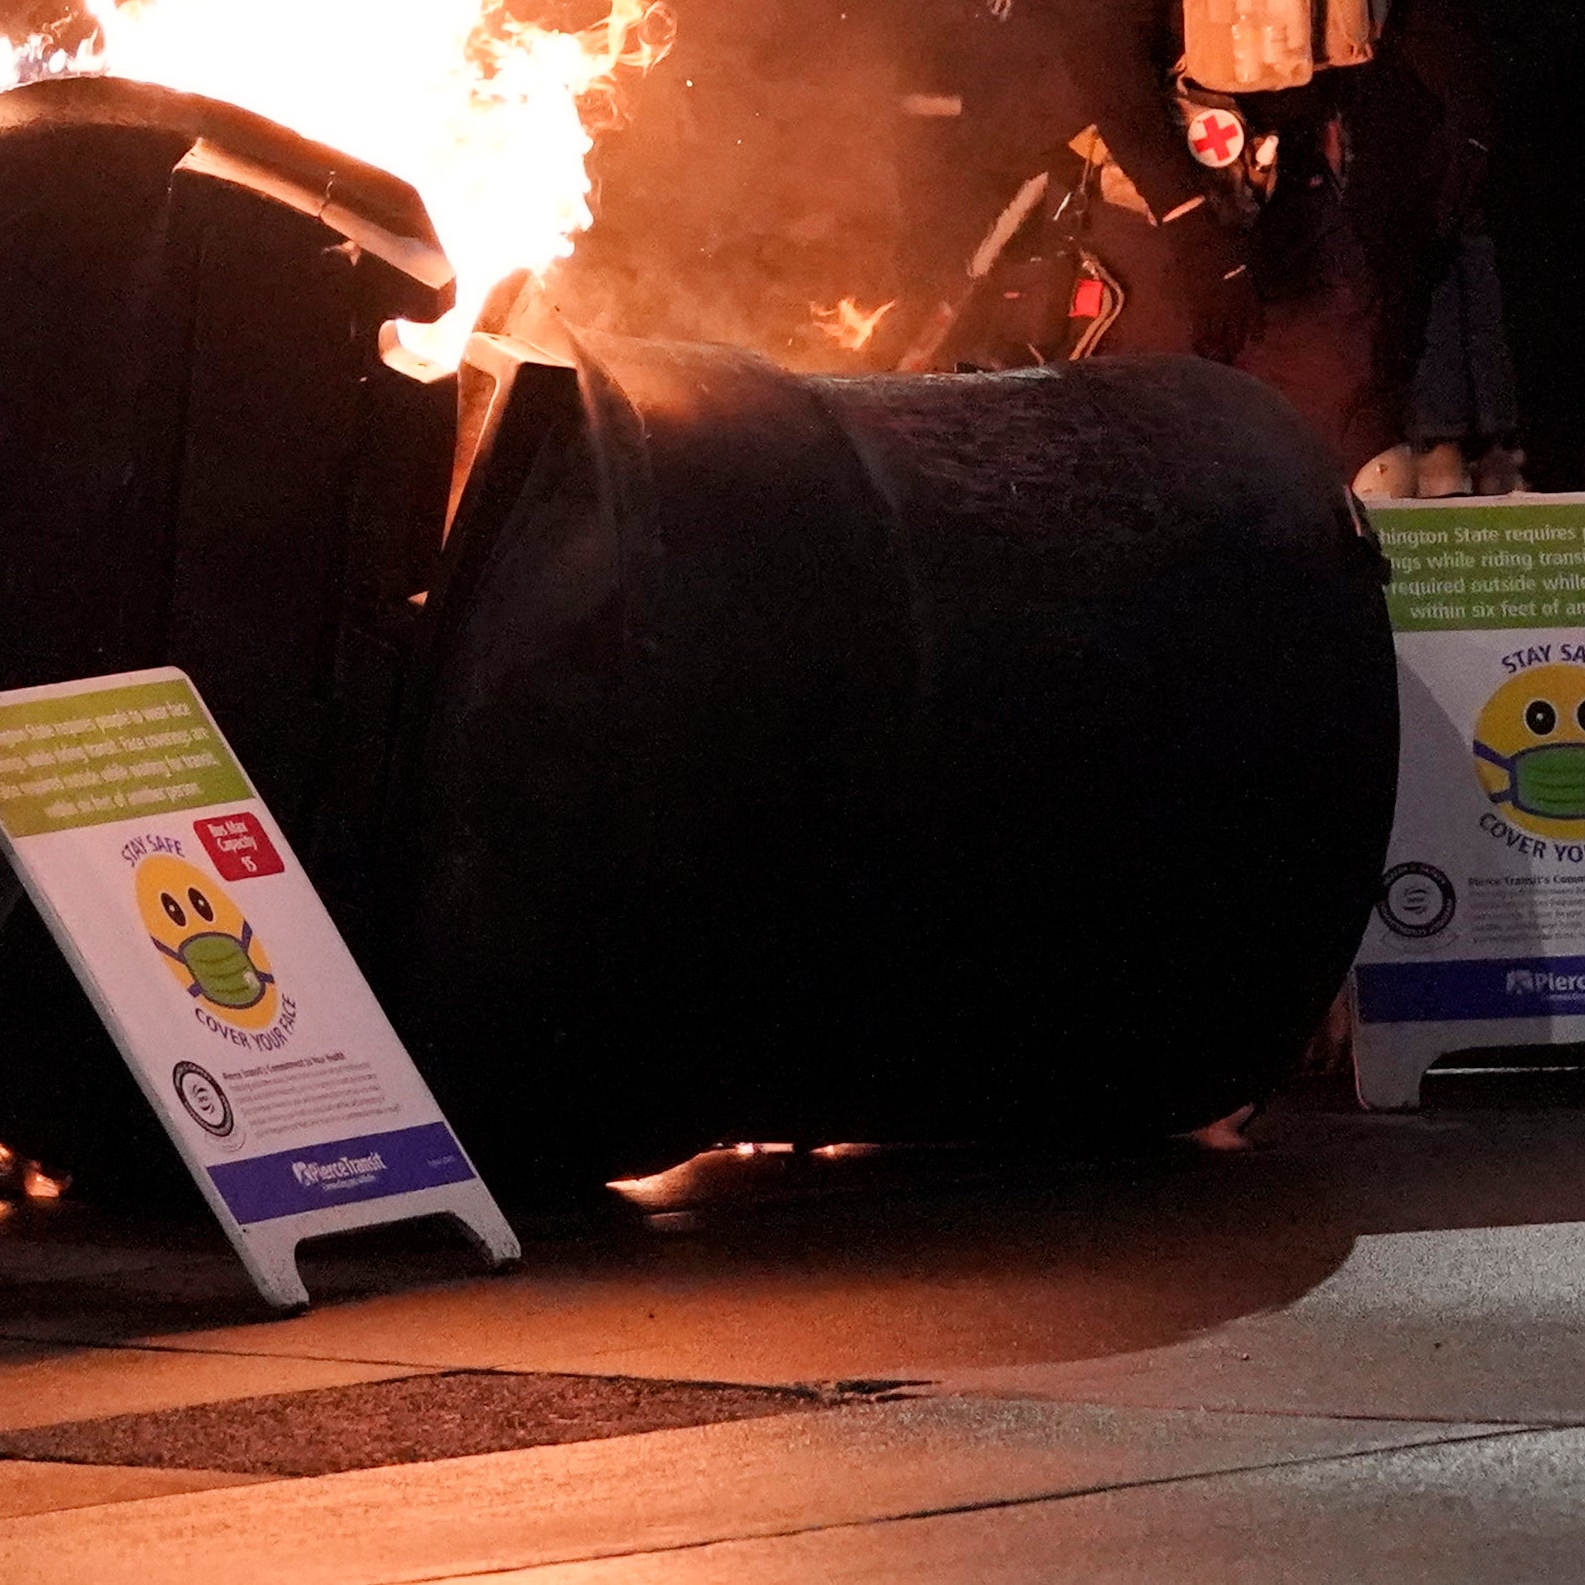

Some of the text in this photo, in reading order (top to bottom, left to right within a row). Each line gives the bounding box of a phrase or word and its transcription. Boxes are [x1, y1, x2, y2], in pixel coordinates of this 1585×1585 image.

[1454, 527, 1499, 543] State
[1505, 524, 1576, 545] requires
[1426, 551, 1475, 568] while
[1481, 551, 1533, 571] riding
[1391, 576, 1465, 597] required
[1470, 574, 1536, 592] outside
[1409, 601, 1466, 620] within
[1471, 601, 1495, 618] six
[1500, 599, 1536, 617] feet
[1542, 599, 1559, 615] of
[1501, 644, 1552, 674] STAY
[1478, 811, 1547, 860] COVER
[121, 834, 186, 868] STAY SAFE
[240, 856, 258, 873] 15
[195, 992, 298, 1053] COVER YOUR FACE
[308, 1152, 387, 1181] PierceTransit
